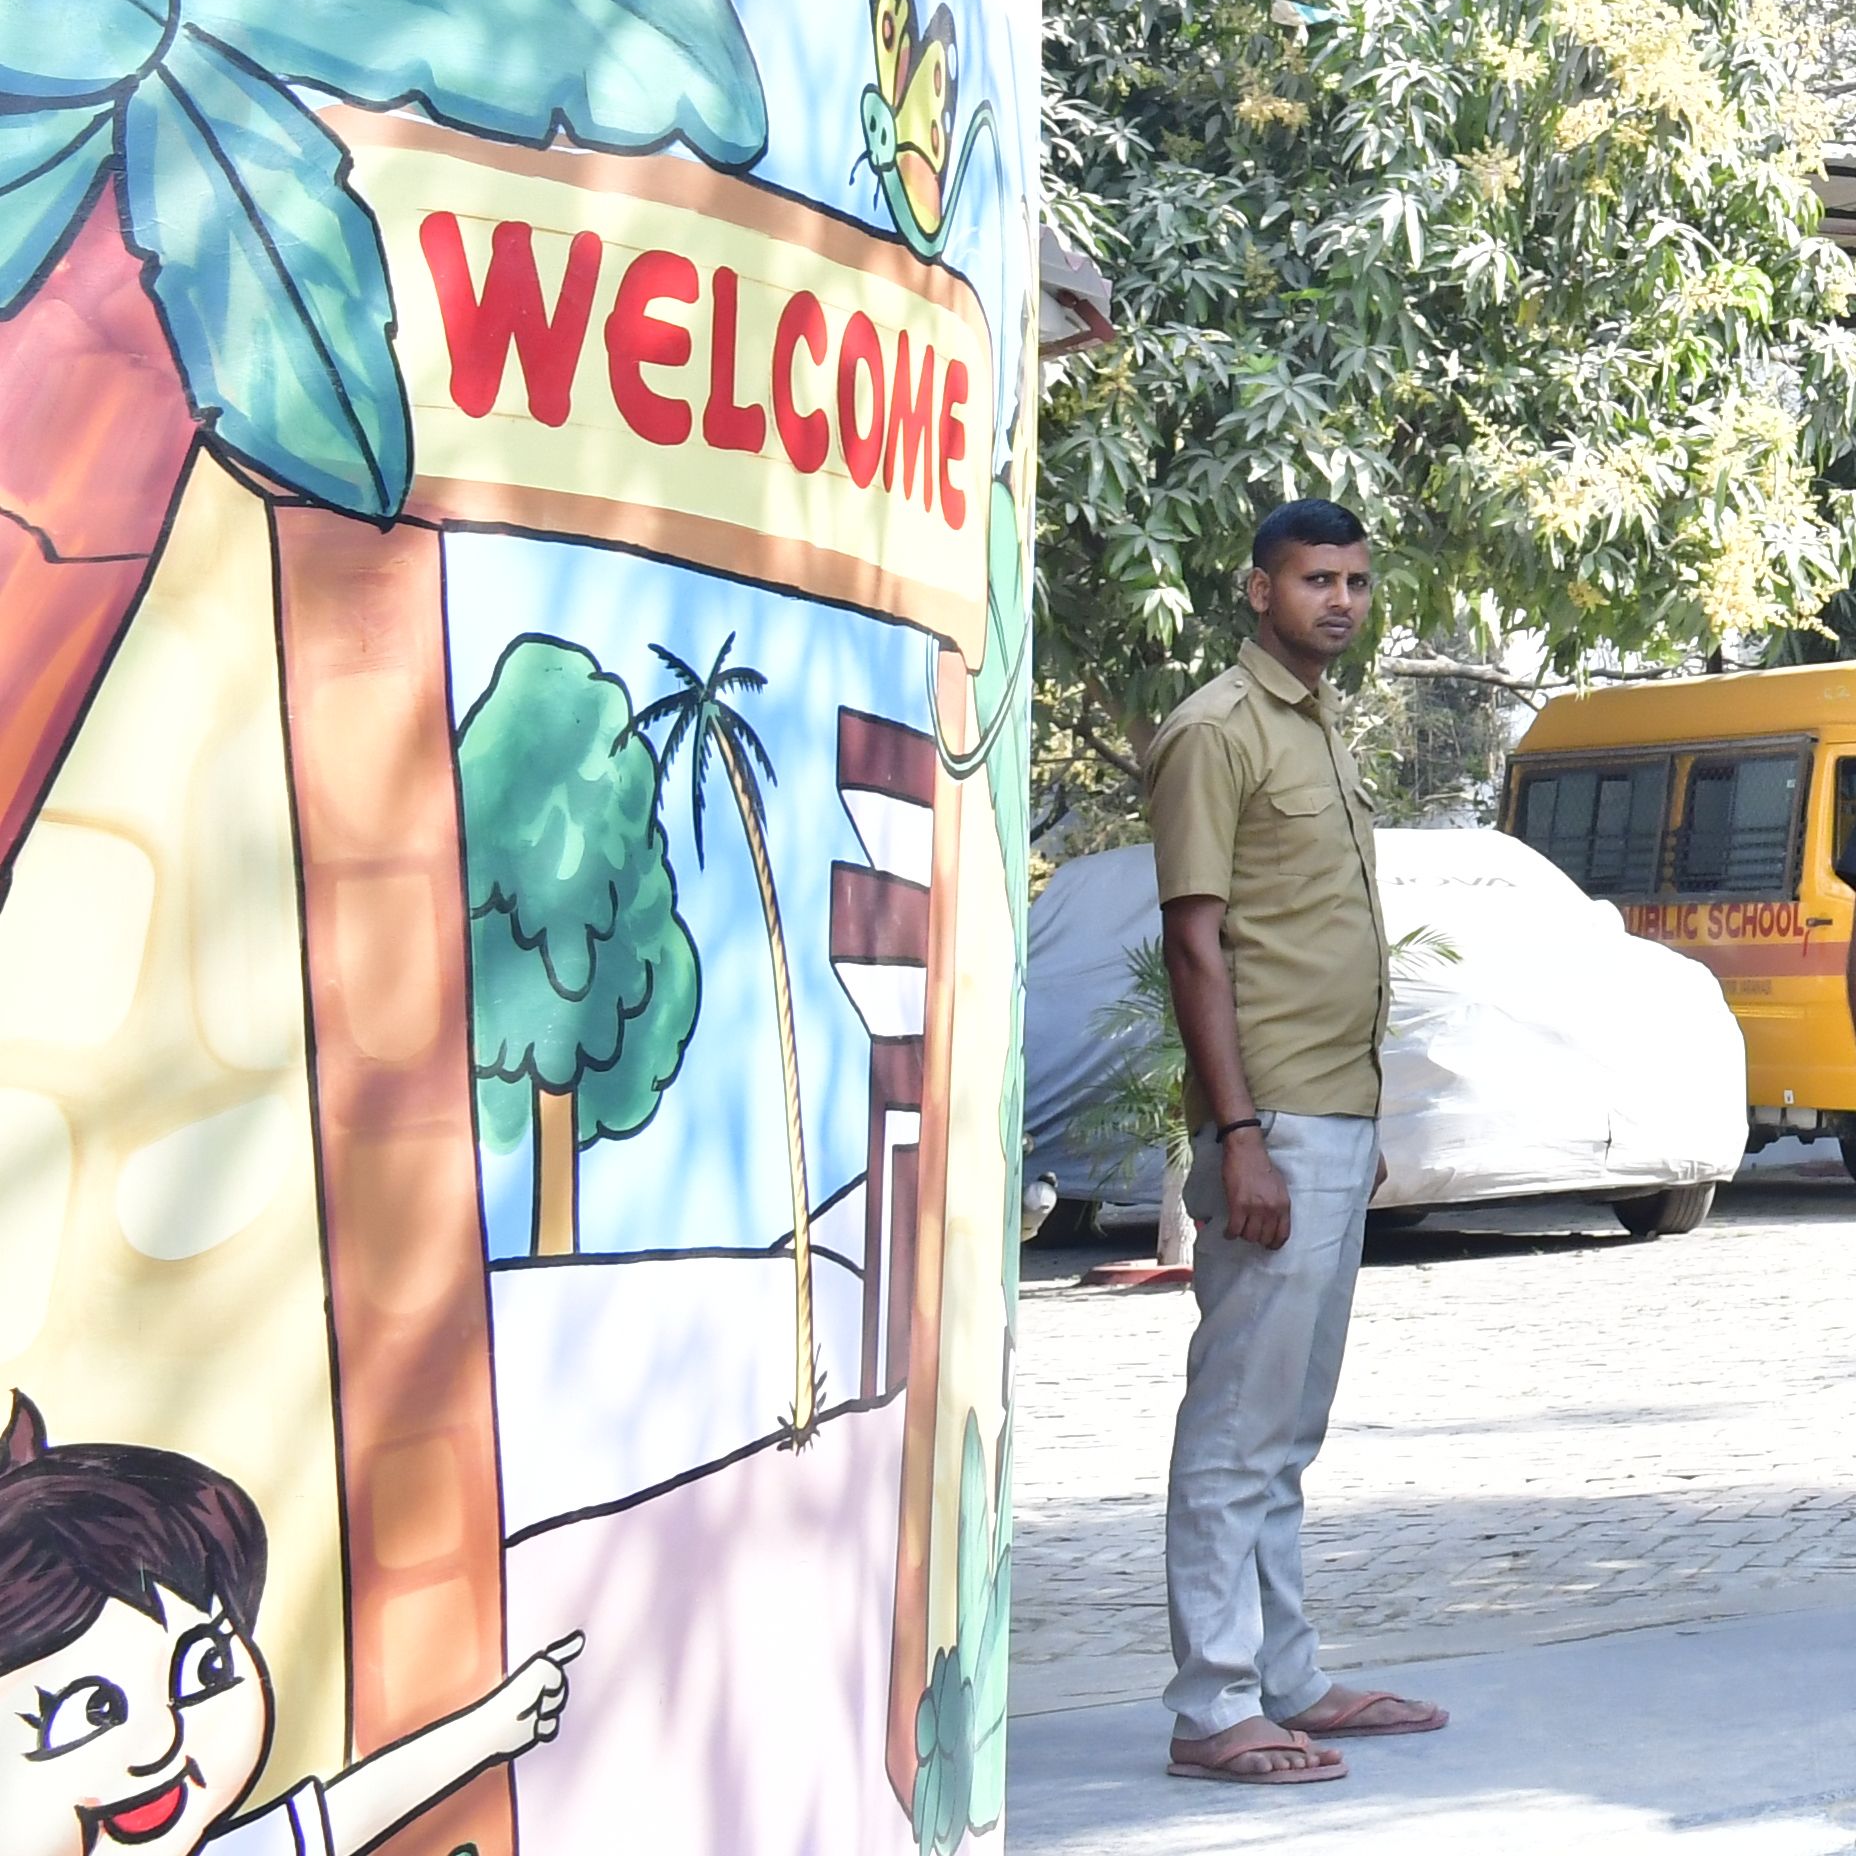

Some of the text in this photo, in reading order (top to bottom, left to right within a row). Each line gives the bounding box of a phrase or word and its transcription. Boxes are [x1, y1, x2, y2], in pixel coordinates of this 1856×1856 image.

[420, 210, 969, 530] WELCOME
[1623, 902, 1805, 940] UBLIC SCHOOL
